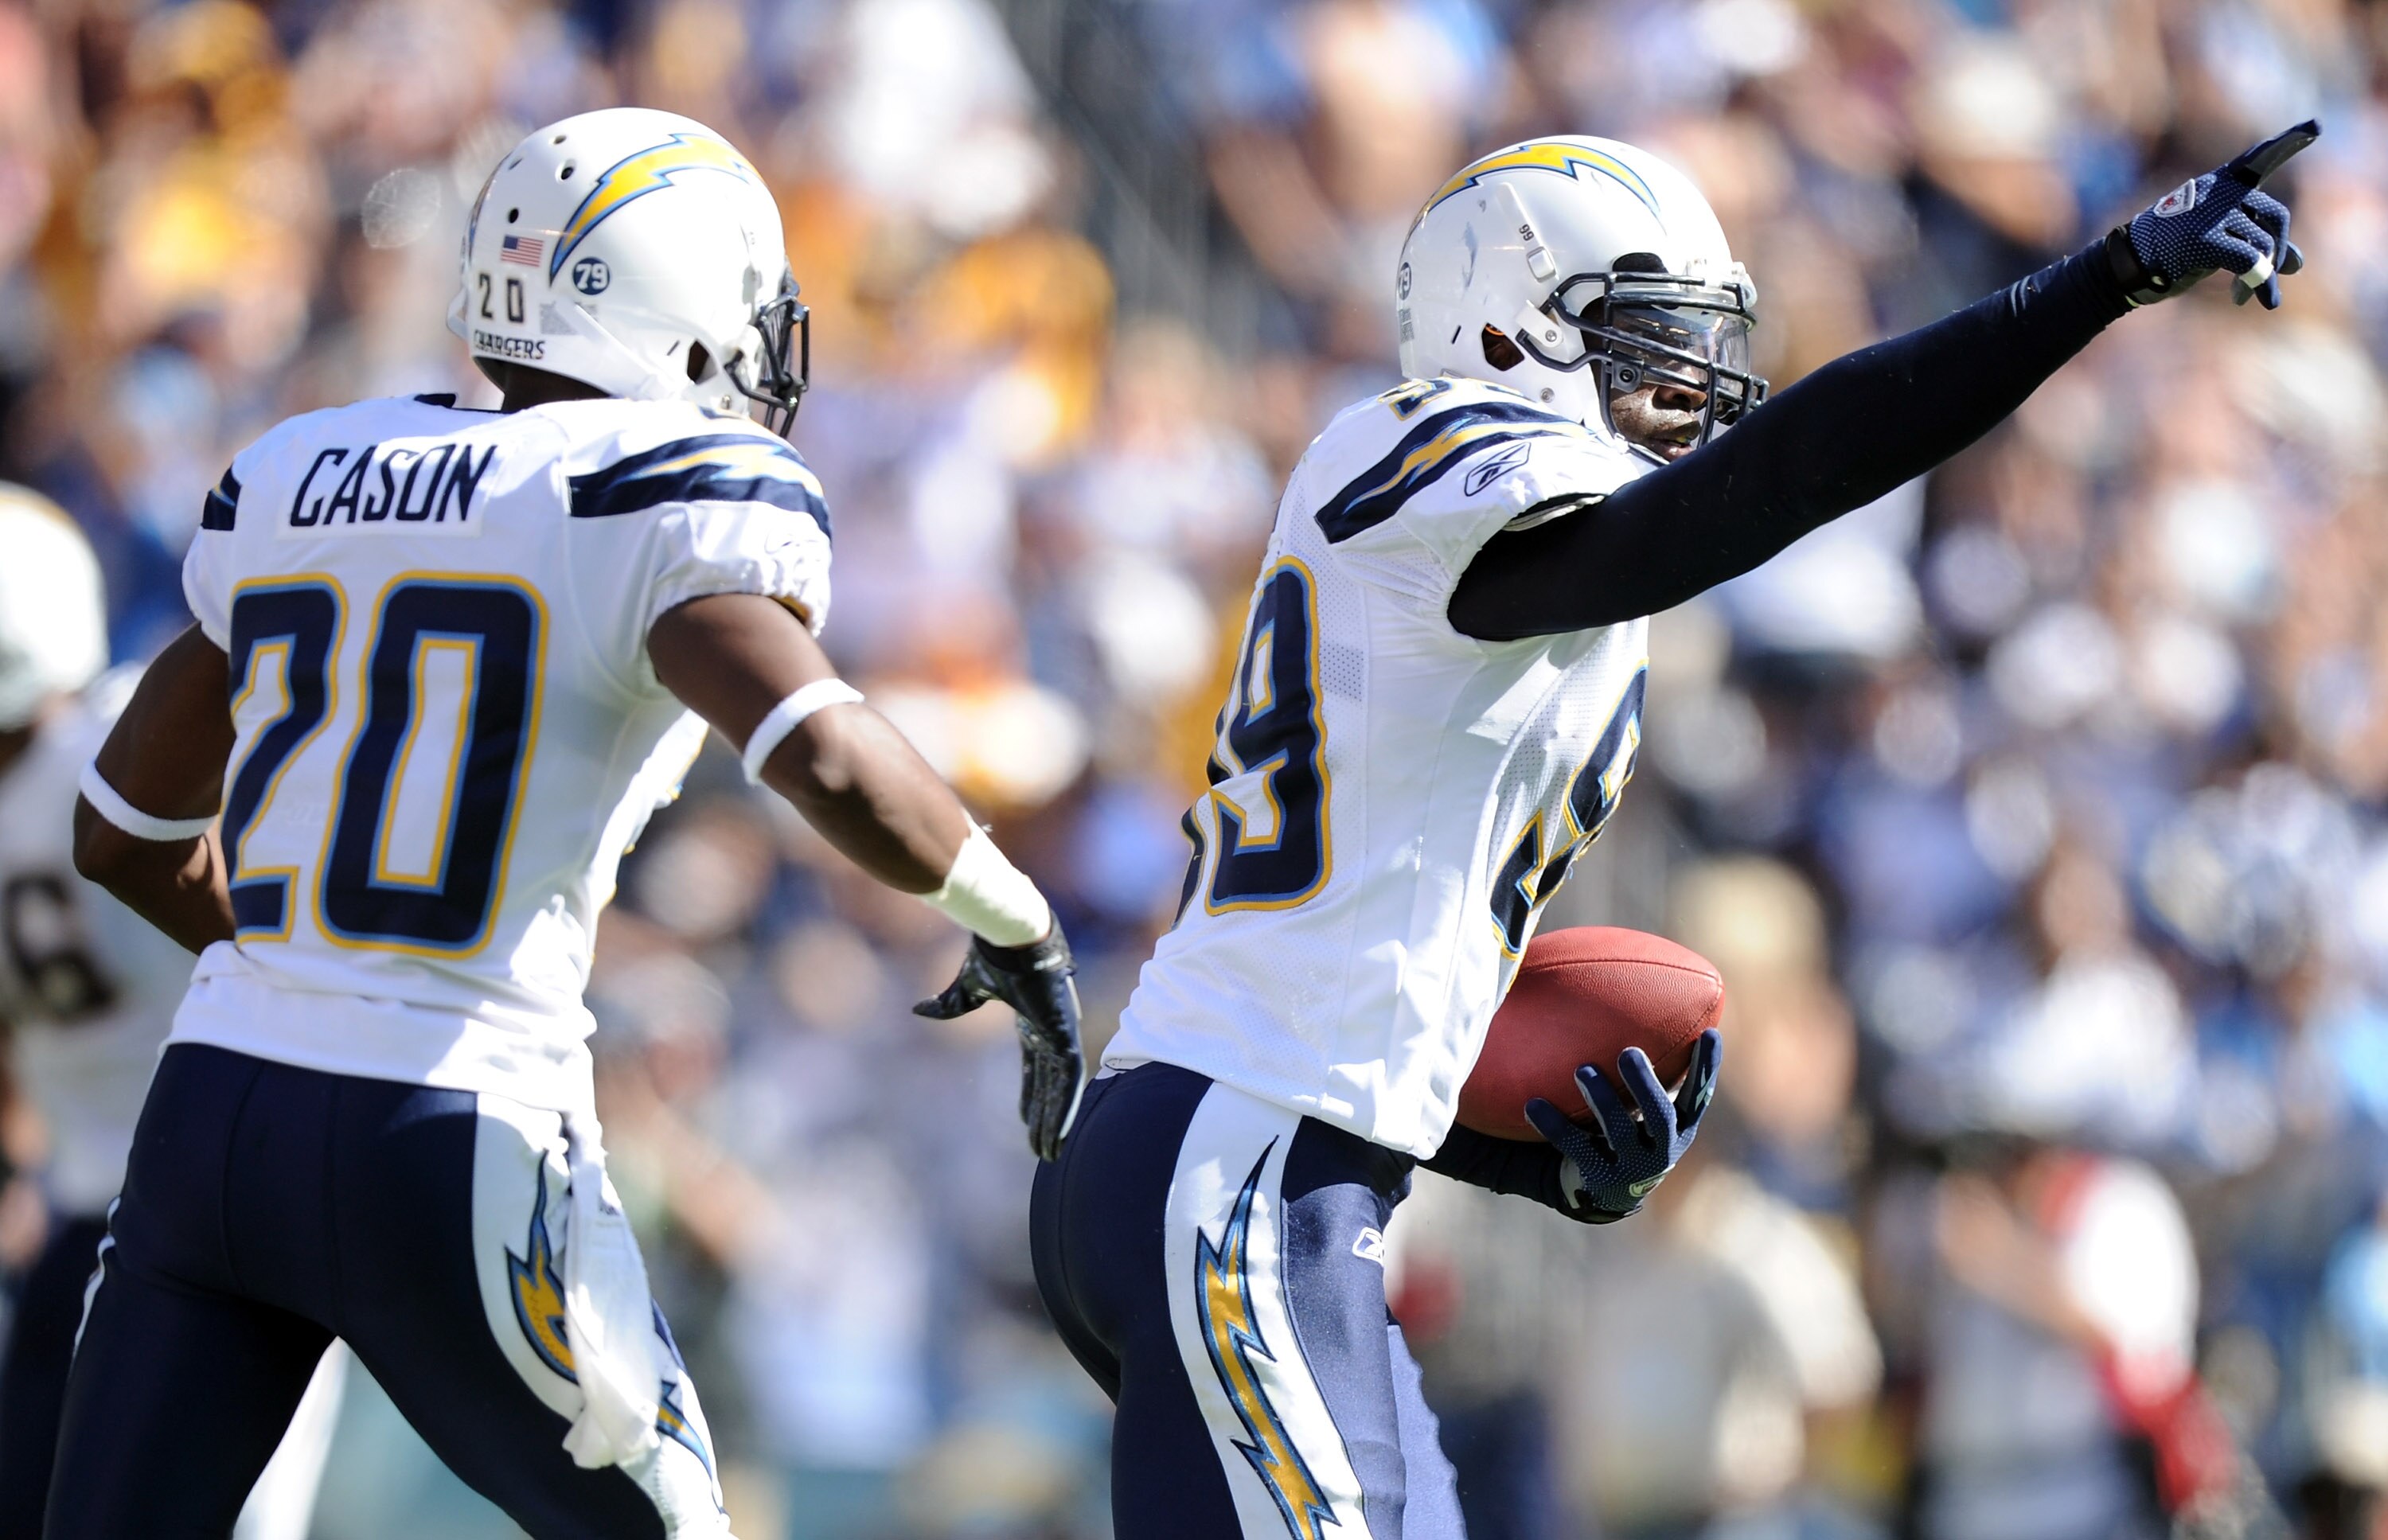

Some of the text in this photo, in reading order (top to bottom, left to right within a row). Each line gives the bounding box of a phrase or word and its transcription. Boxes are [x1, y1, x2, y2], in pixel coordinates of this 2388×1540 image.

[1519, 224, 1535, 241] 99
[576, 263, 608, 290] 79
[478, 272, 524, 323] 20
[474, 329, 545, 360] CHARGERS
[290, 443, 498, 527] CASON
[220, 569, 549, 956] 20
